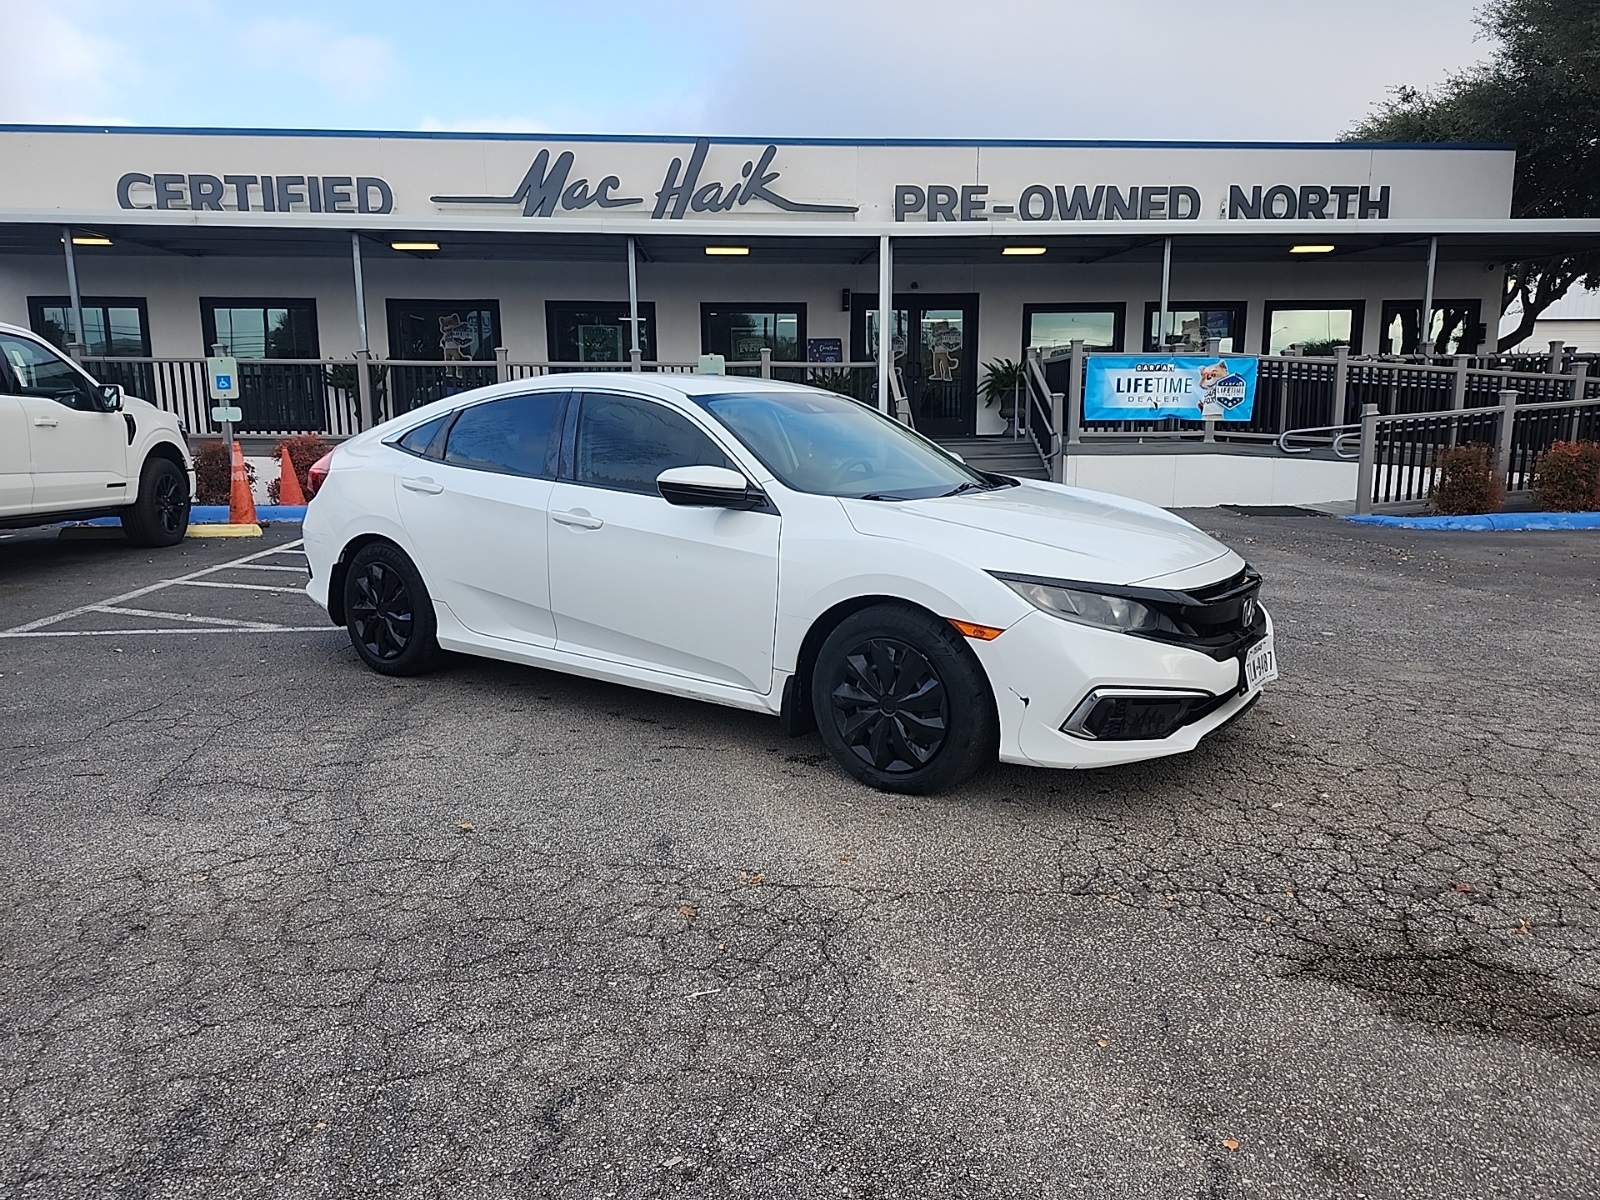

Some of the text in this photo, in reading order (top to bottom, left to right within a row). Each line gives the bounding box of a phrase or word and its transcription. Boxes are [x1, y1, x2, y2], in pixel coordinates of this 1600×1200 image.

[116, 172, 393, 214] CERTIFIED
[430, 137, 860, 219] Mac Haik
[894, 184, 1391, 222] PRE-OWNED NORTH
[1116, 377, 1192, 394] LIFETIME
[1135, 364, 1175, 372] CARFAX
